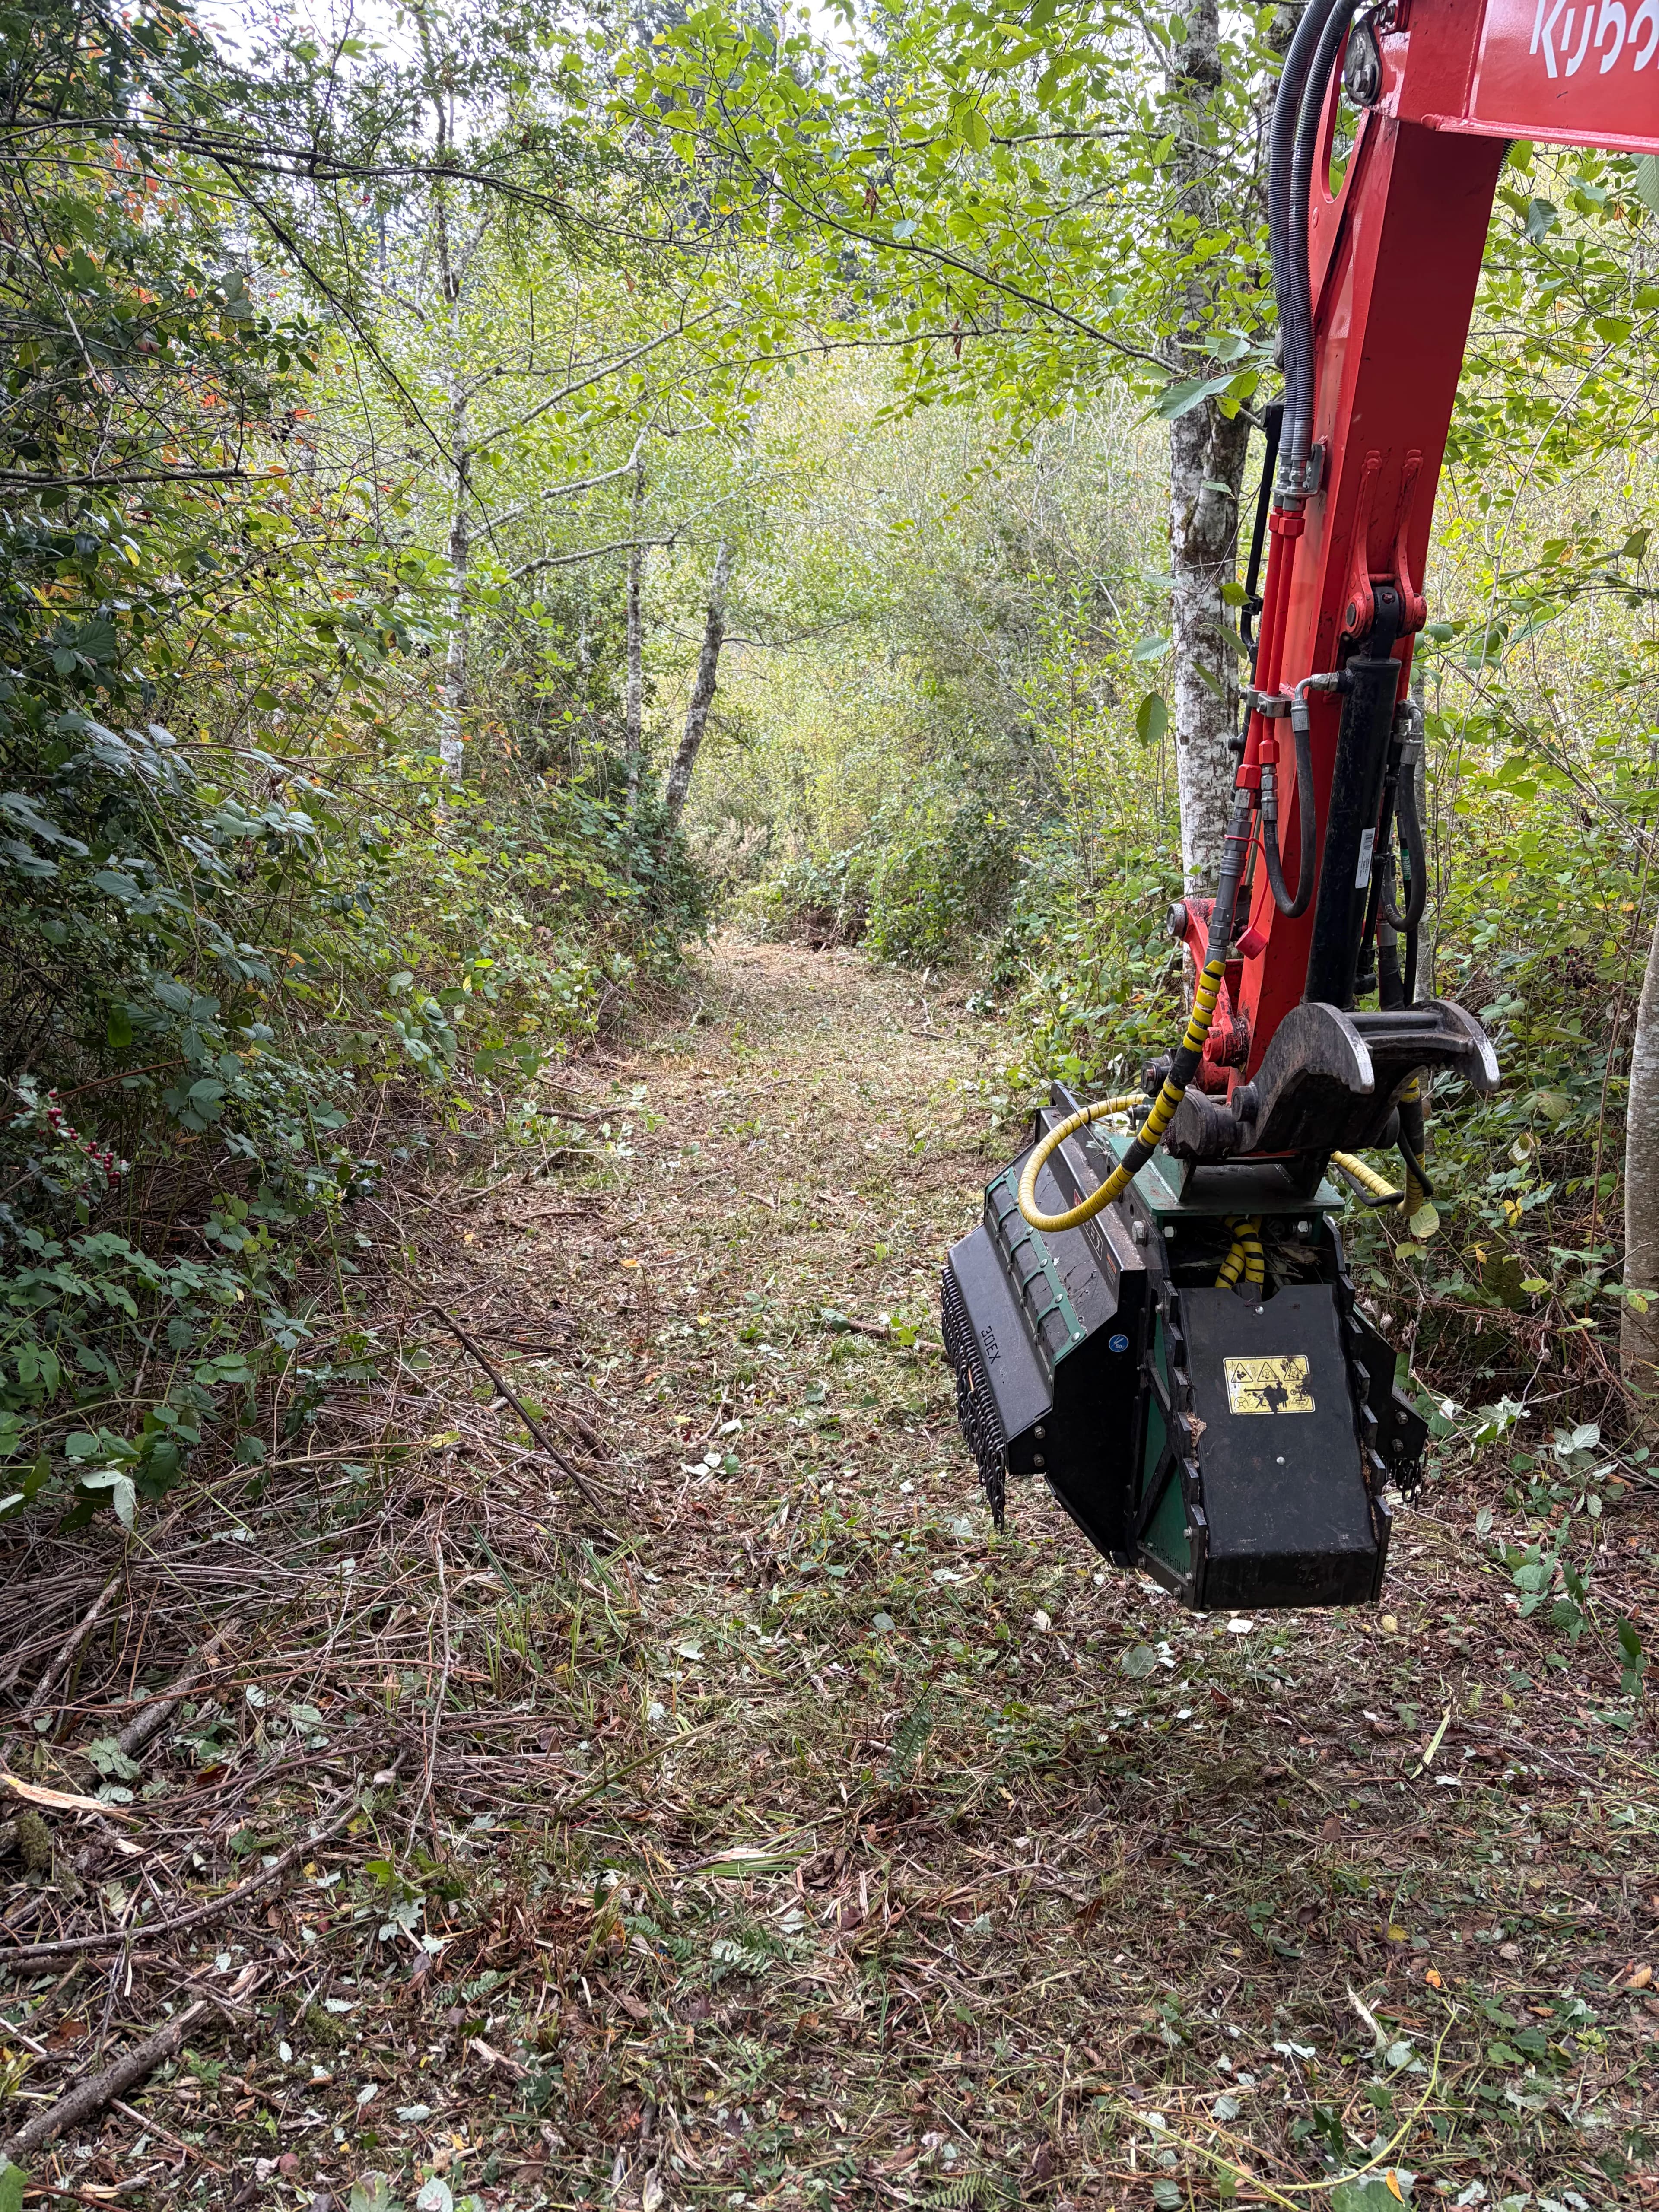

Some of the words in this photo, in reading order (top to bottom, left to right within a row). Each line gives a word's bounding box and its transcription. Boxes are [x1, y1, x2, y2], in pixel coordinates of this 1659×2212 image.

[1529, 0, 1659, 78] Kubo
[1402, 856, 1411, 874] DRAIN
[981, 1325, 1001, 1365] 30EX
